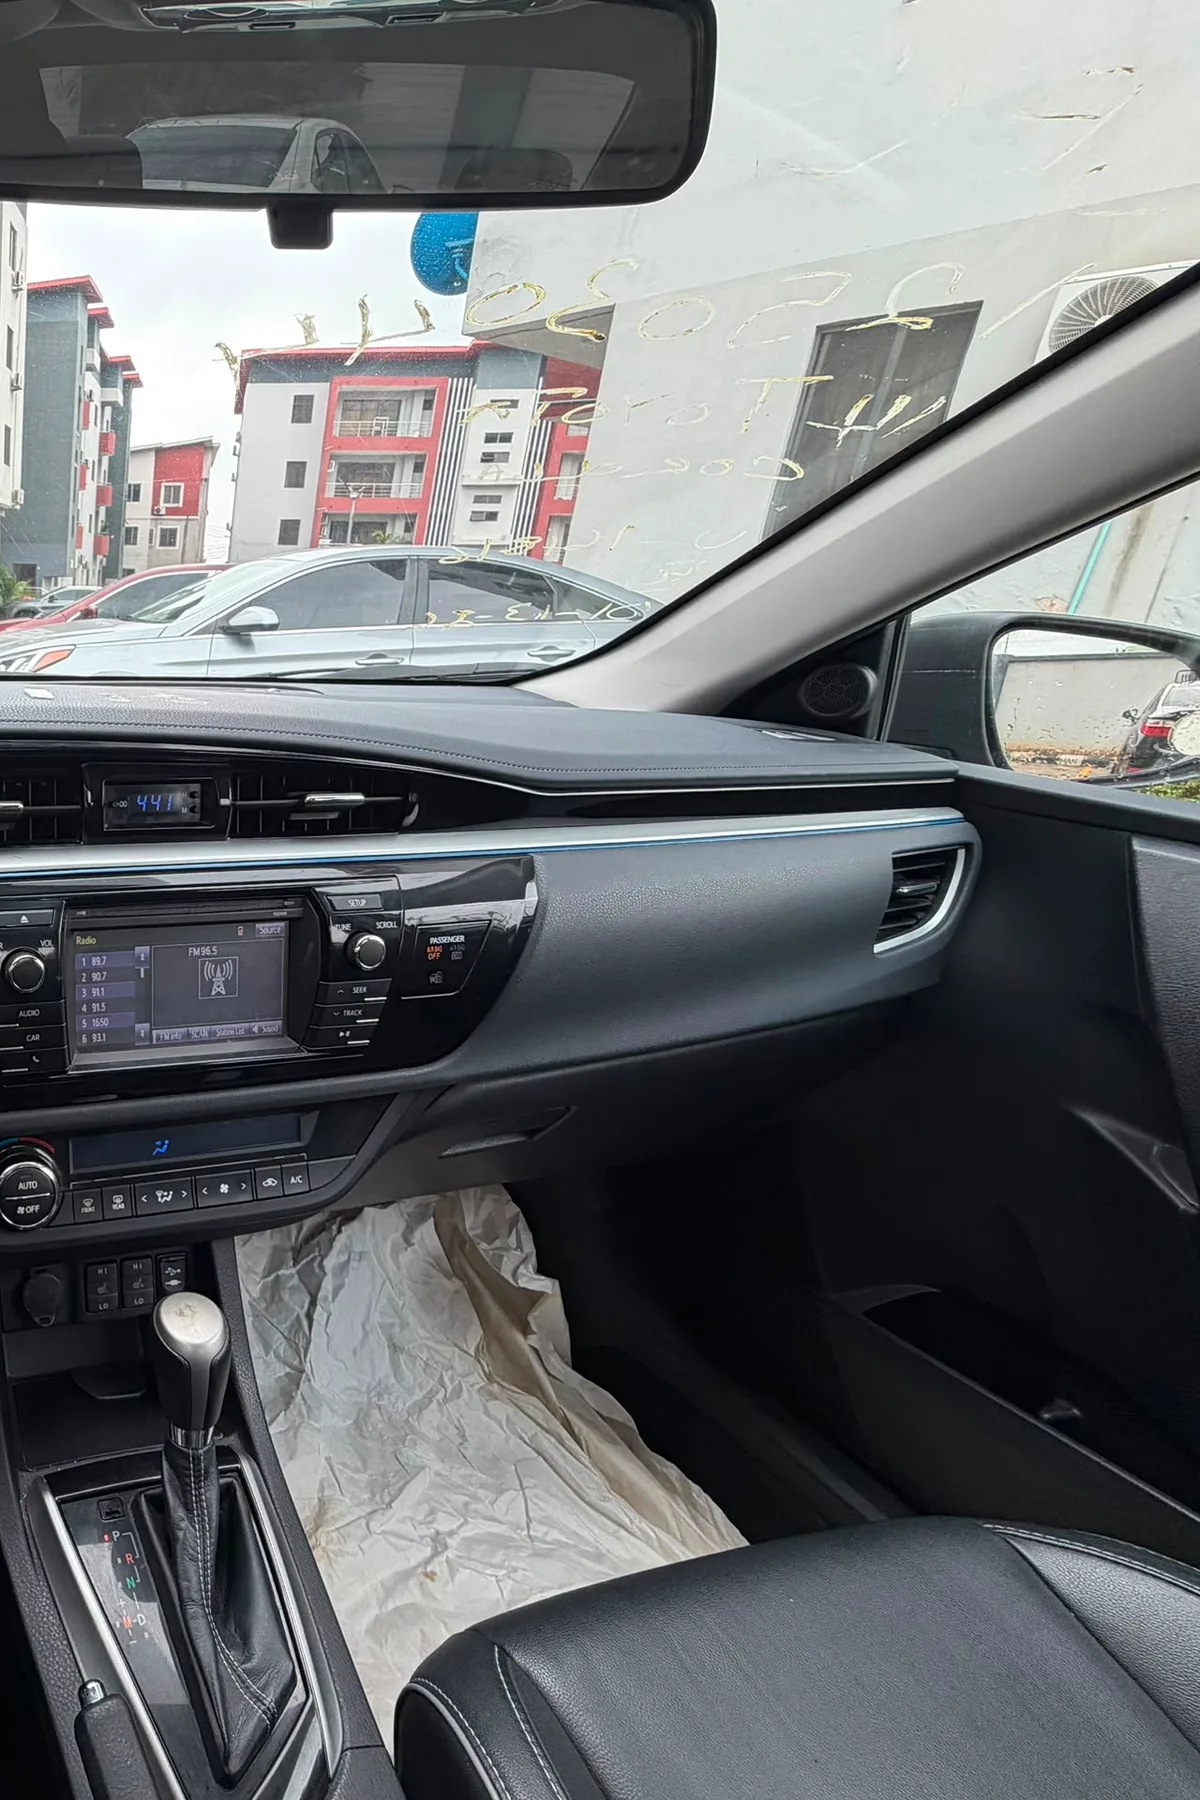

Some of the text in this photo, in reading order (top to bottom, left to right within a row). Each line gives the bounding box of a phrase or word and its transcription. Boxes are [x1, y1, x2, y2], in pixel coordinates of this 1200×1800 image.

[347, 899, 367, 907] SETUP
[259, 925, 281, 935] Source
[375, 920, 398, 930] SCROLL
[40, 939, 54, 947] VOL
[75, 935, 97, 946] Radio
[429, 935, 465, 944] PASSENGER
[82, 956, 107, 966] 1 89.7
[427, 952, 441, 960] OFF
[81, 971, 107, 982] 2 90.7
[81, 987, 105, 997] 3 91.1
[352, 985, 367, 993] SEEK
[81, 1002, 106, 1012] 4 91.5
[343, 1008, 362, 1016] TRACK
[18, 1009, 40, 1018] AUDIO
[81, 1019, 87, 1028] 5
[26, 1033, 40, 1042] CAR
[81, 1032, 106, 1043] 6 93.1
[18, 1180, 38, 1190] AUTO
[26, 1204, 40, 1213] OFF
[134, 1297, 144, 1305] LO
[112, 1530, 121, 1542] P
[124, 1553, 134, 1564] R
[126, 1576, 136, 1589] N
[123, 1615, 133, 1629] M
[137, 1613, 146, 1626] D
